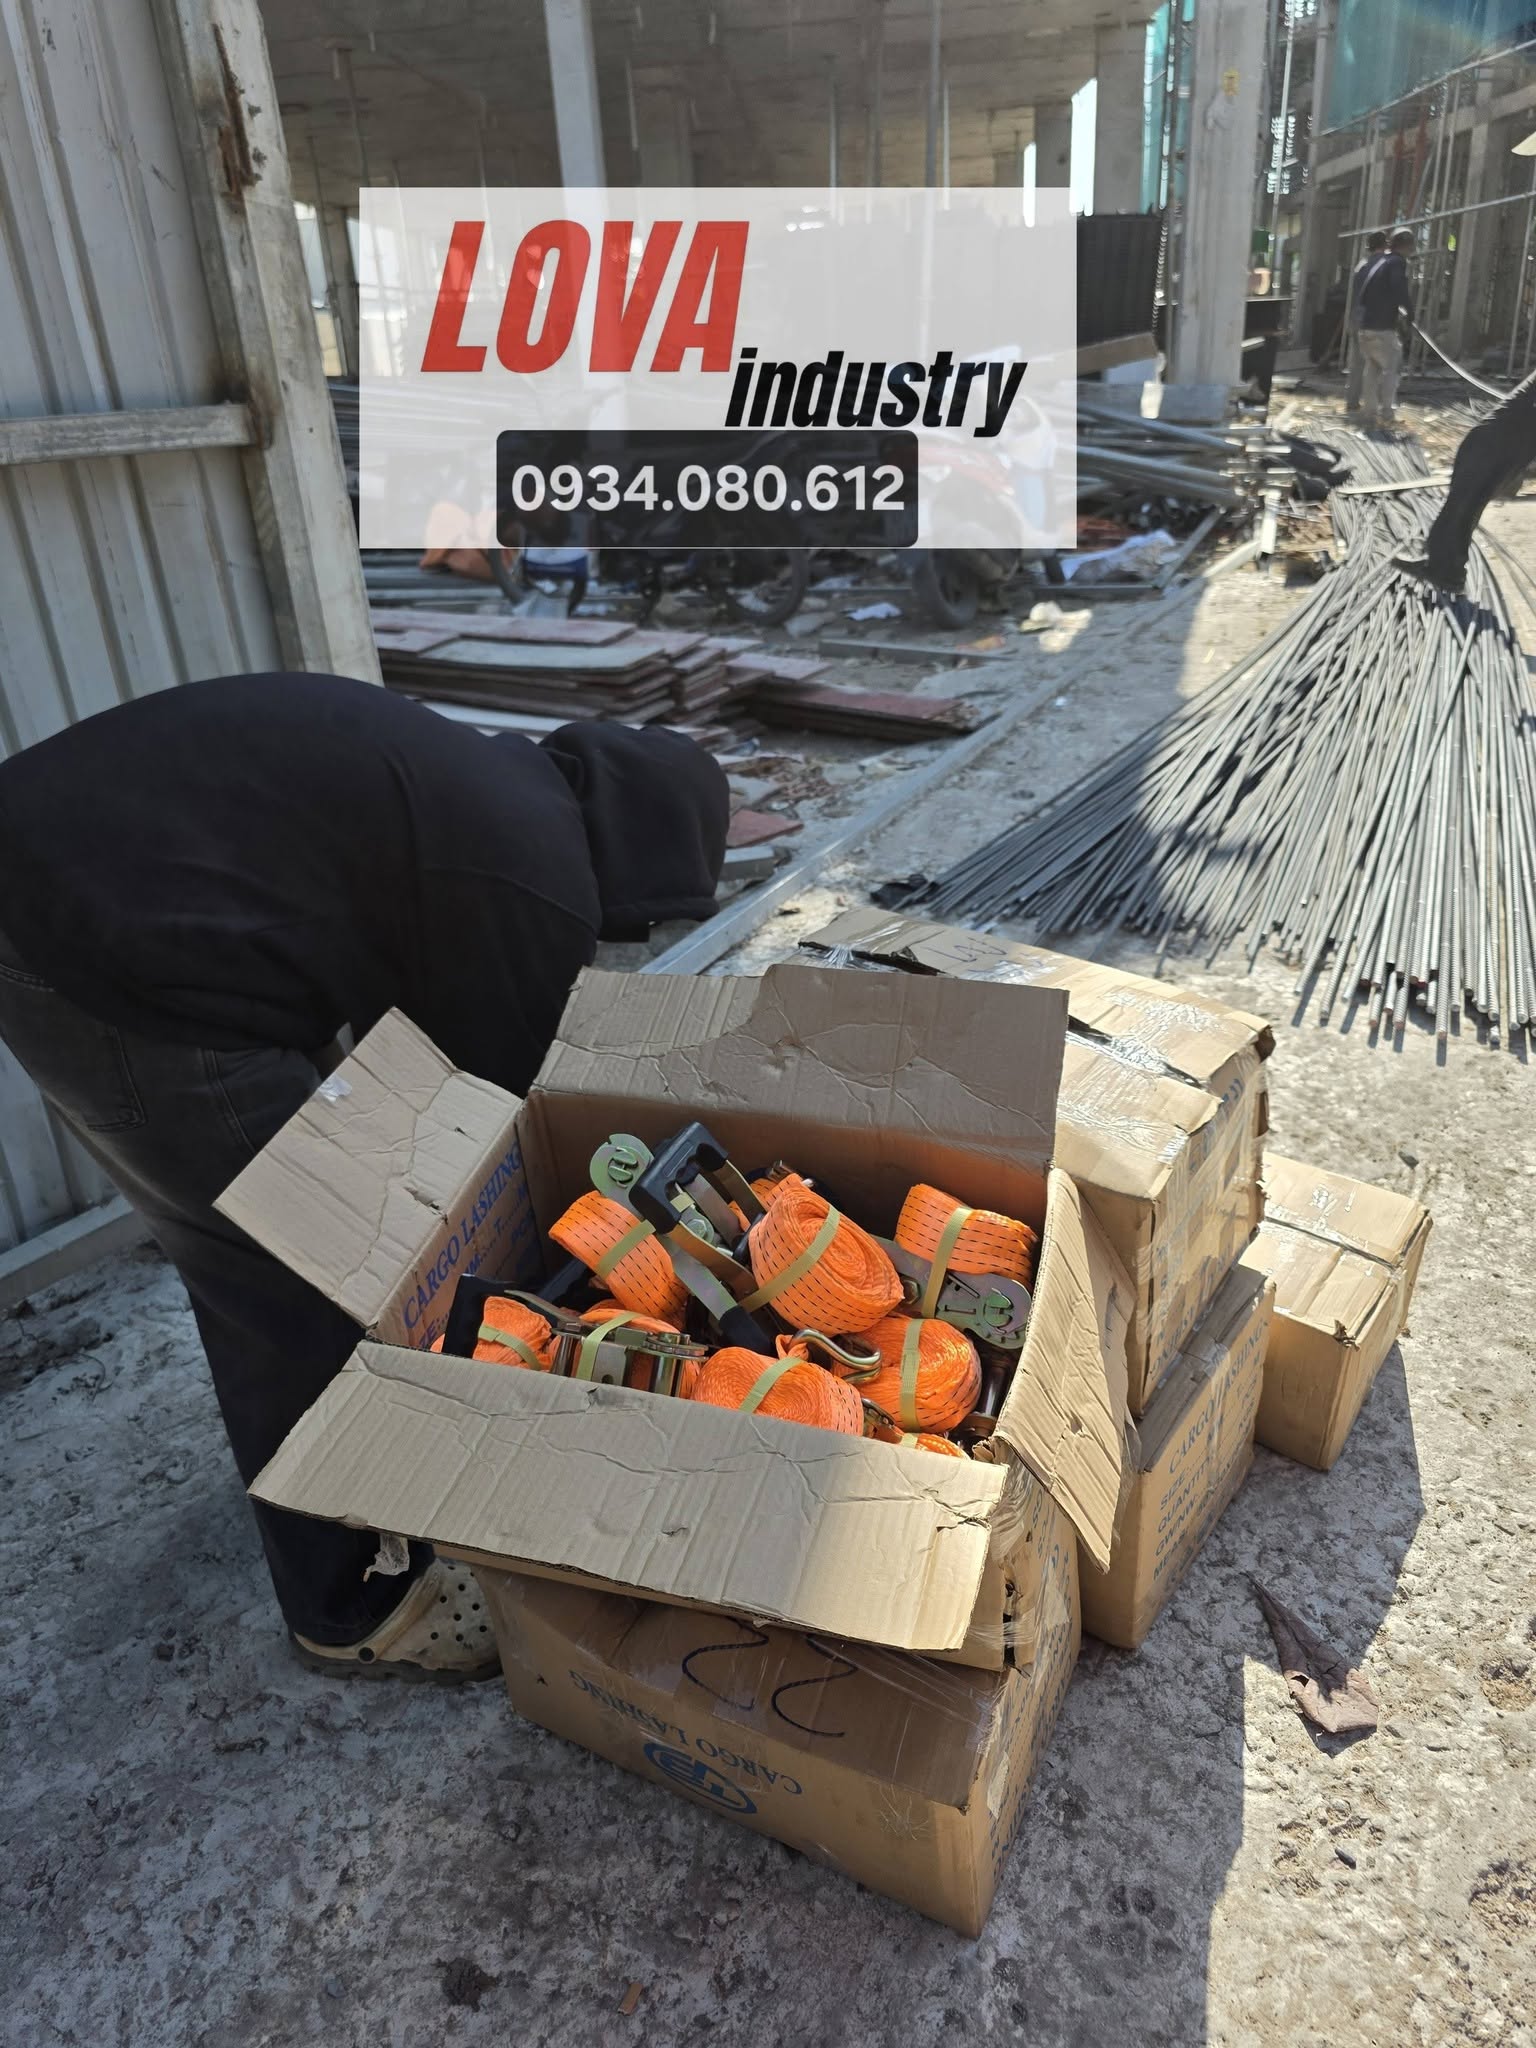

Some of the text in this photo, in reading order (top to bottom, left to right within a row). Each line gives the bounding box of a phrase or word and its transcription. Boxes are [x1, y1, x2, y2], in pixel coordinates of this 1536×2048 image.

[403, 1236, 461, 1329] CARGO
[1169, 1399, 1215, 1474] CARGO
[568, 1669, 803, 1795] CARGO LASHING
